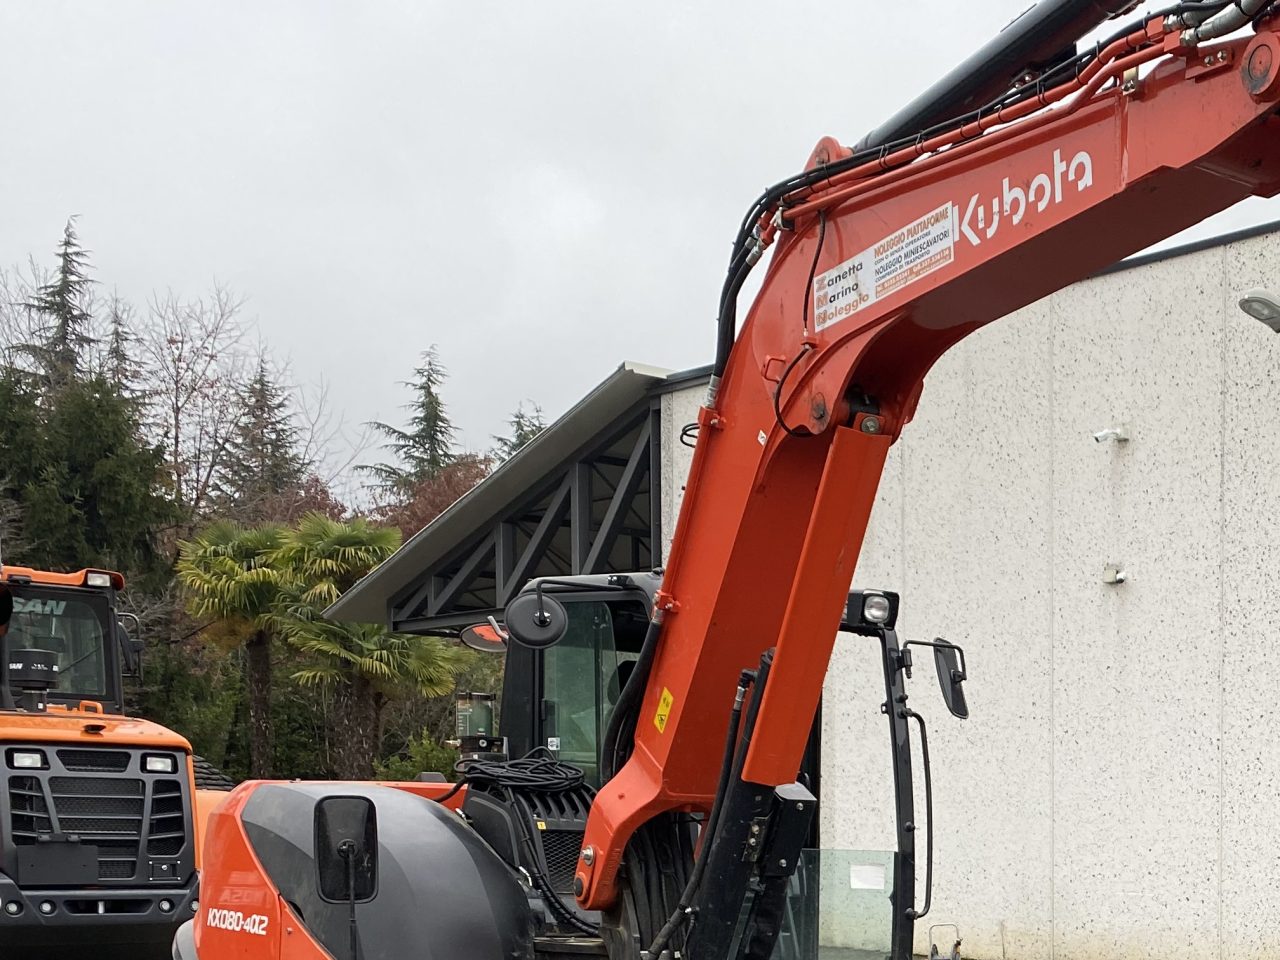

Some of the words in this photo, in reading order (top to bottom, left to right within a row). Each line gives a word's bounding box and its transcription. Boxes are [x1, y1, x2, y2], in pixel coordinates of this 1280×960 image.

[953, 148, 1093, 247] Kubota
[874, 231, 906, 258] NOLEGGIO
[906, 206, 949, 241] PIATTAFORME
[874, 254, 903, 277] NOLEGGIO
[903, 229, 950, 261] MINIESCAVATORI
[815, 261, 864, 292] Zanetta
[816, 281, 860, 310] Marino
[816, 292, 870, 328] Noleggio
